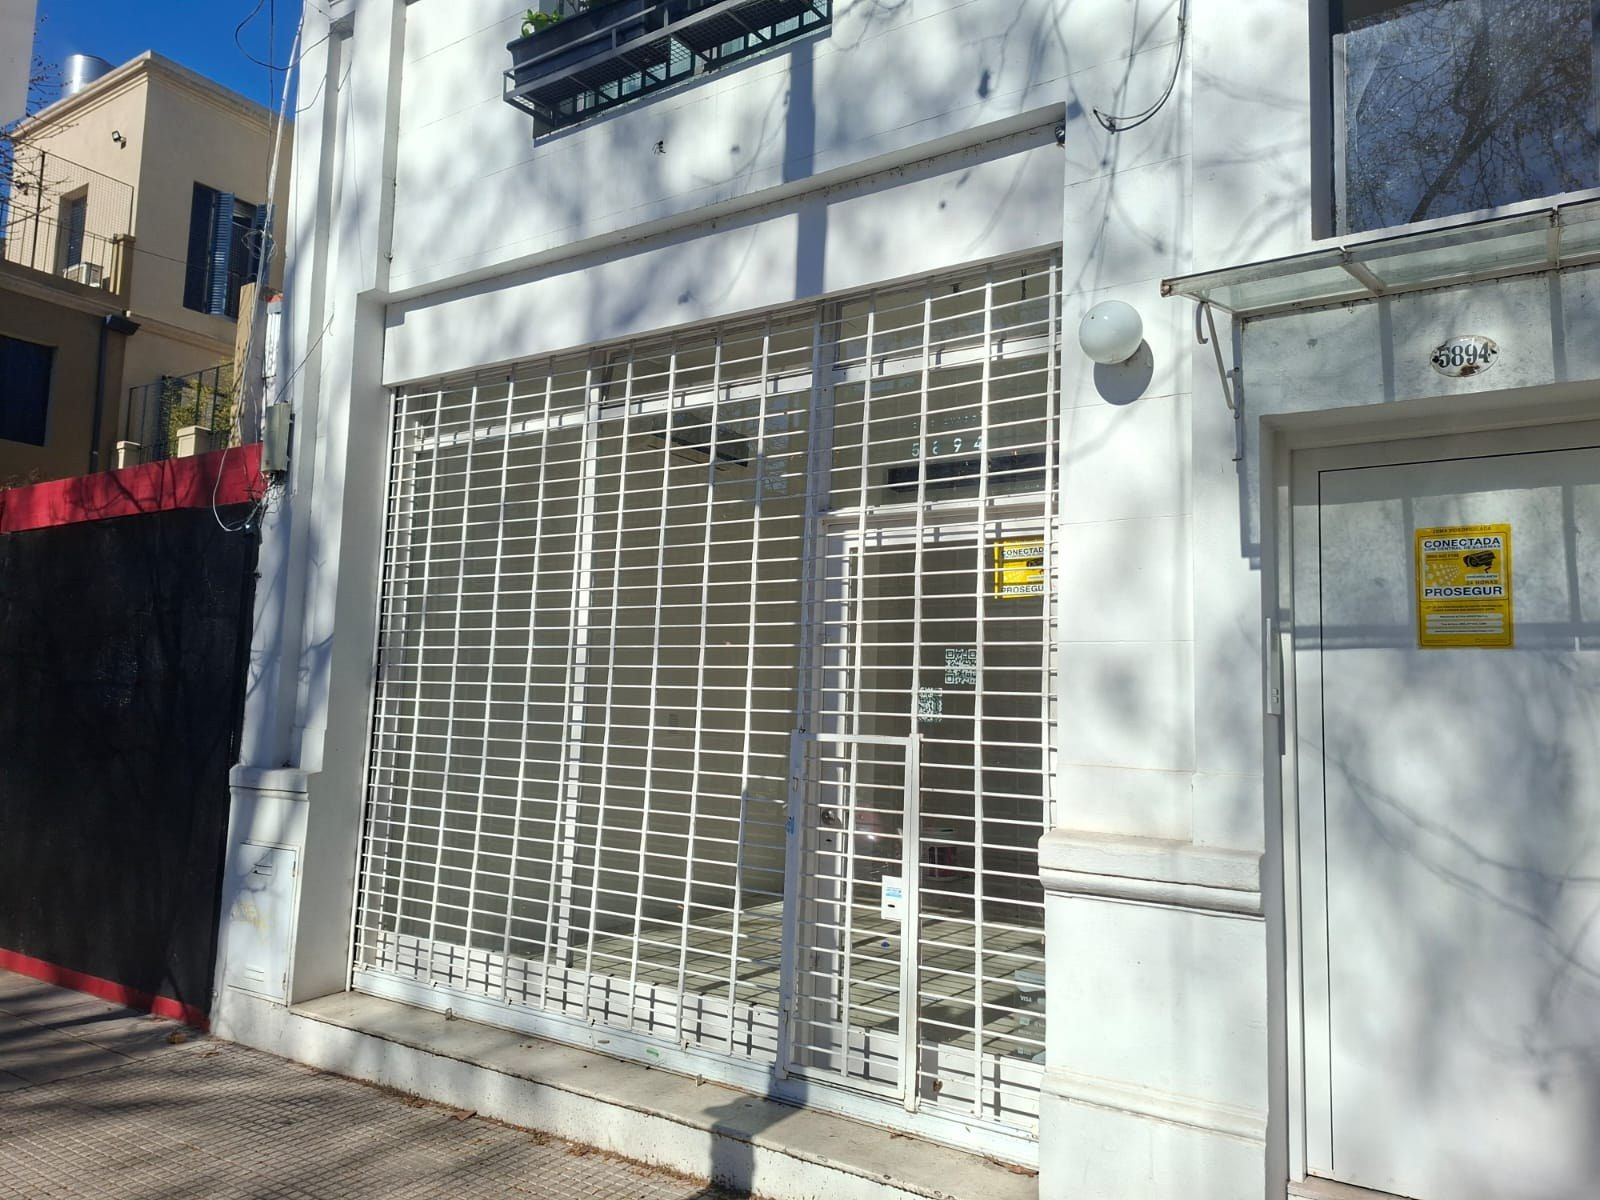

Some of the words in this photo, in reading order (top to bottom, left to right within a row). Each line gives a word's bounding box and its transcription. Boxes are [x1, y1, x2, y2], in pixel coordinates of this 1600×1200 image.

[1438, 341, 1490, 368] 5894
[1424, 537, 1501, 548] CONECTADA
[1001, 547, 1044, 557] CONECTAD
[1001, 585, 1044, 593] PROSEGU
[1425, 586, 1502, 597] PROSEGUR
